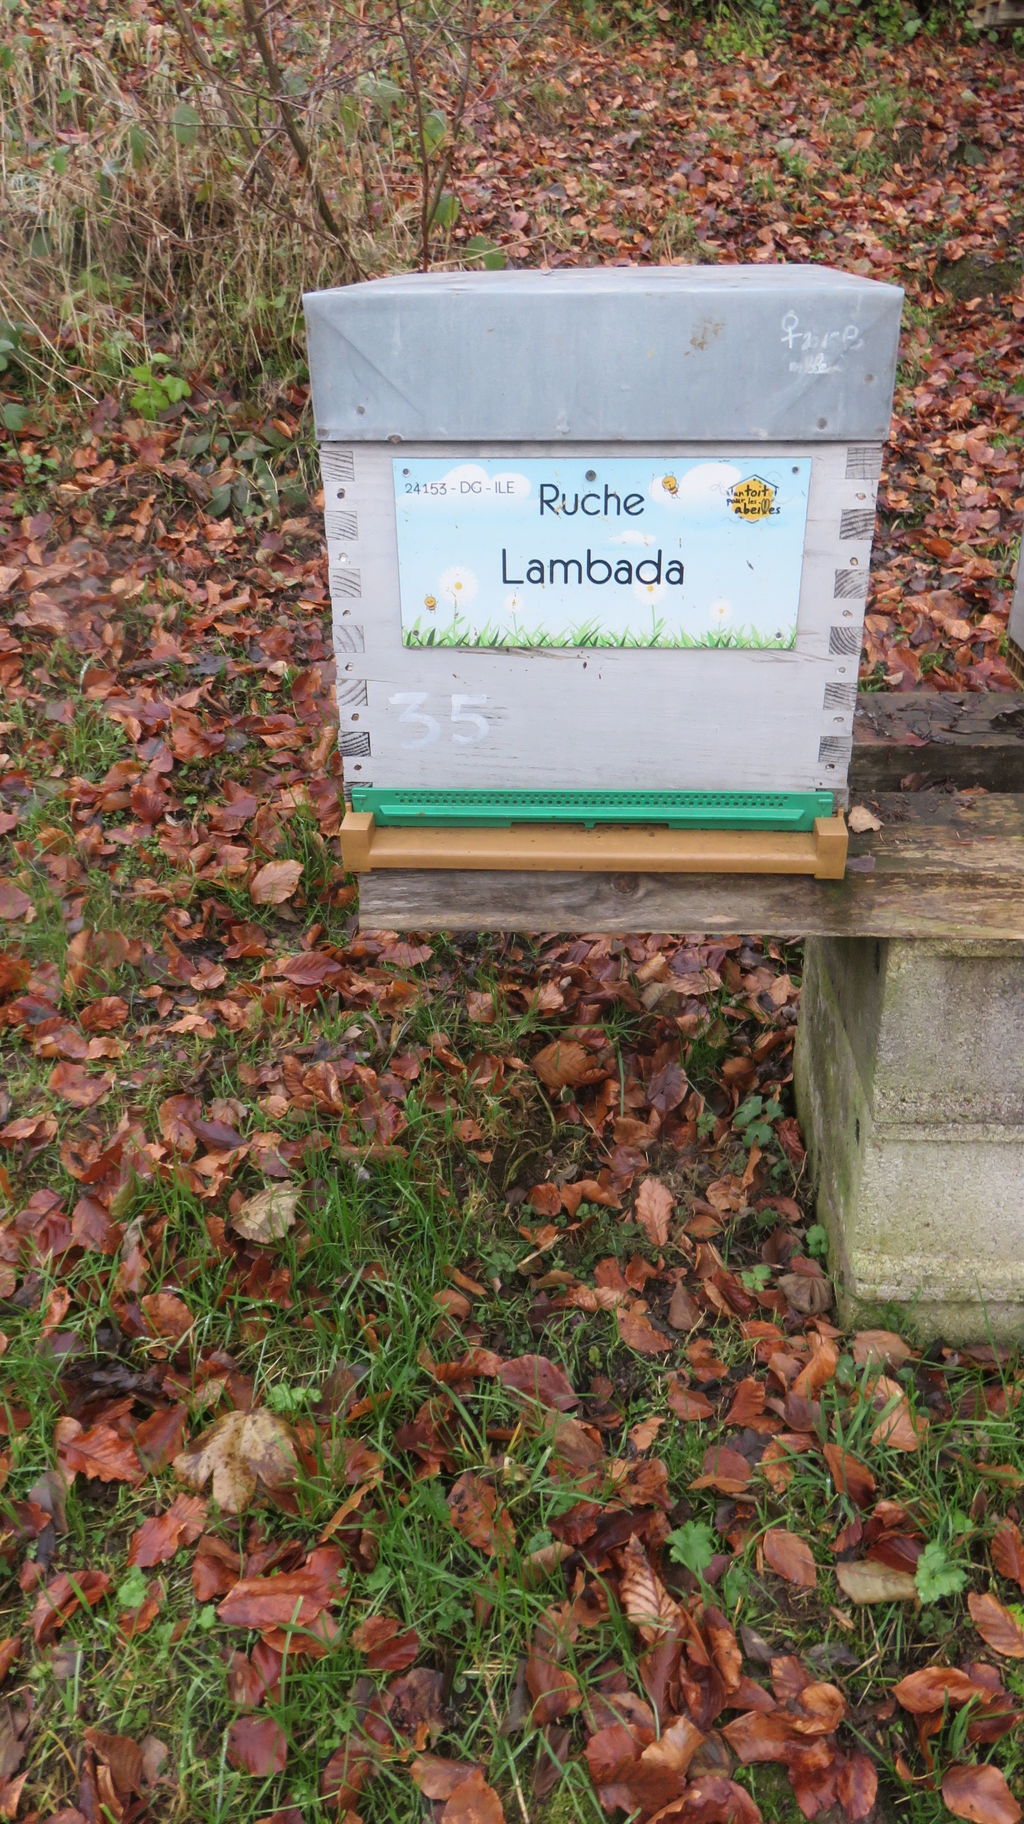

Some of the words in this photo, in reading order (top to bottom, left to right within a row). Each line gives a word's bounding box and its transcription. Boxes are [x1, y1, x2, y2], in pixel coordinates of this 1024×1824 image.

[404, 482, 447, 495] 24153
[460, 480, 482, 494] DG
[495, 480, 515, 494] ILE
[745, 484, 769, 497] toit
[539, 483, 644, 516] Ruche
[726, 498, 745, 507] pour
[734, 499, 781, 515] abeilles
[502, 548, 684, 585] Lambada
[387, 692, 490, 749] 35
